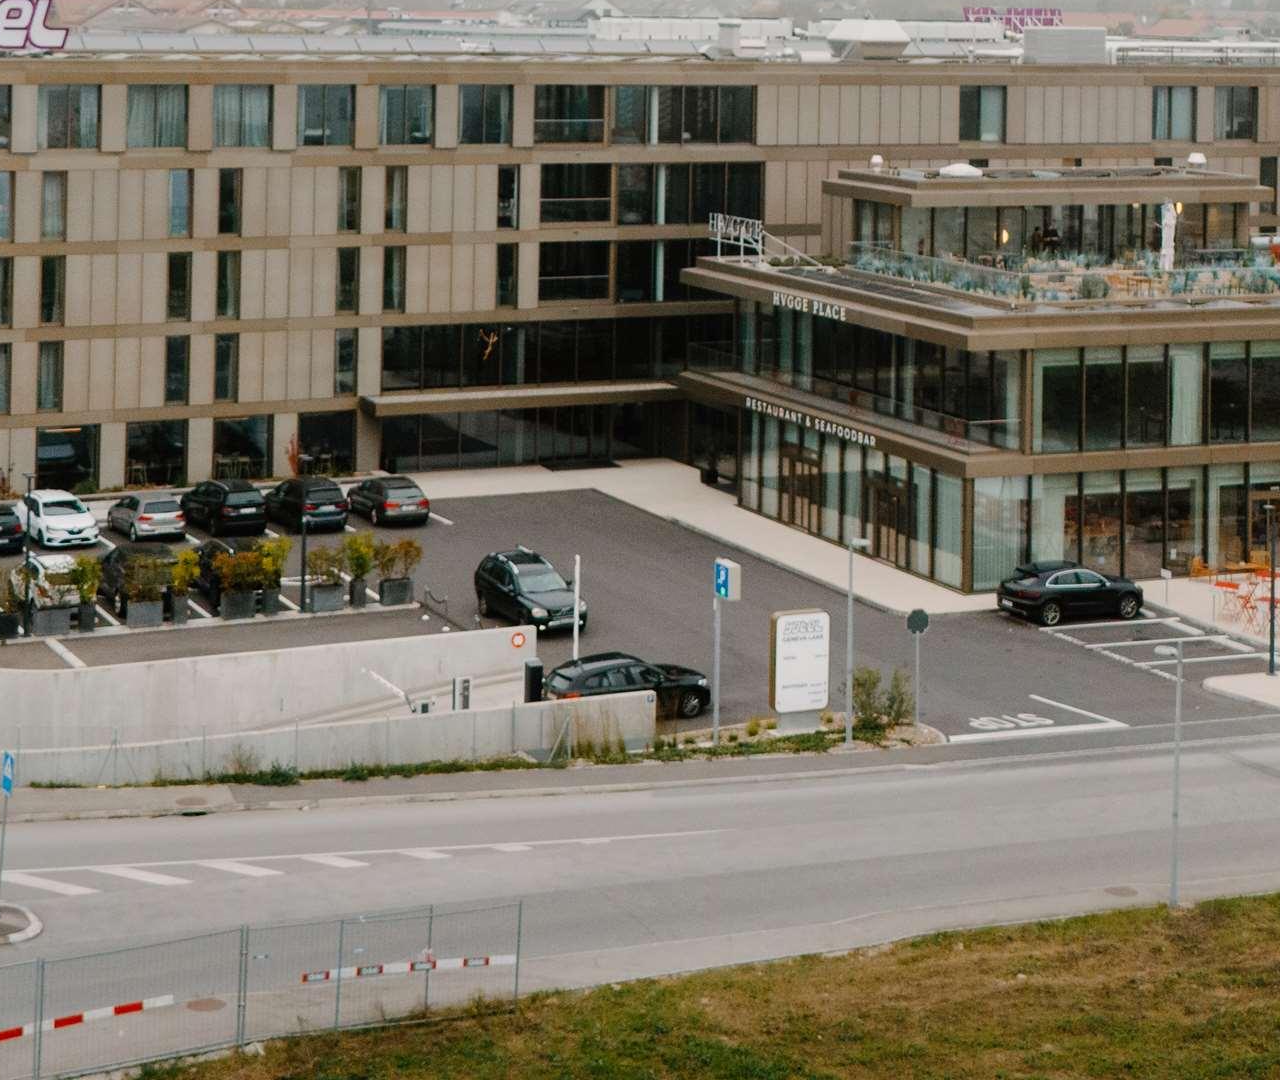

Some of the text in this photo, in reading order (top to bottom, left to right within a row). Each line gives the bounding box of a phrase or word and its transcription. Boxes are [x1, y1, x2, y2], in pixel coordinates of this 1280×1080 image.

[812, 300, 847, 321] PLACE
[745, 396, 877, 447] RESTAURANT & SEAFOODBAR
[968, 713, 1054, 730] STOP
